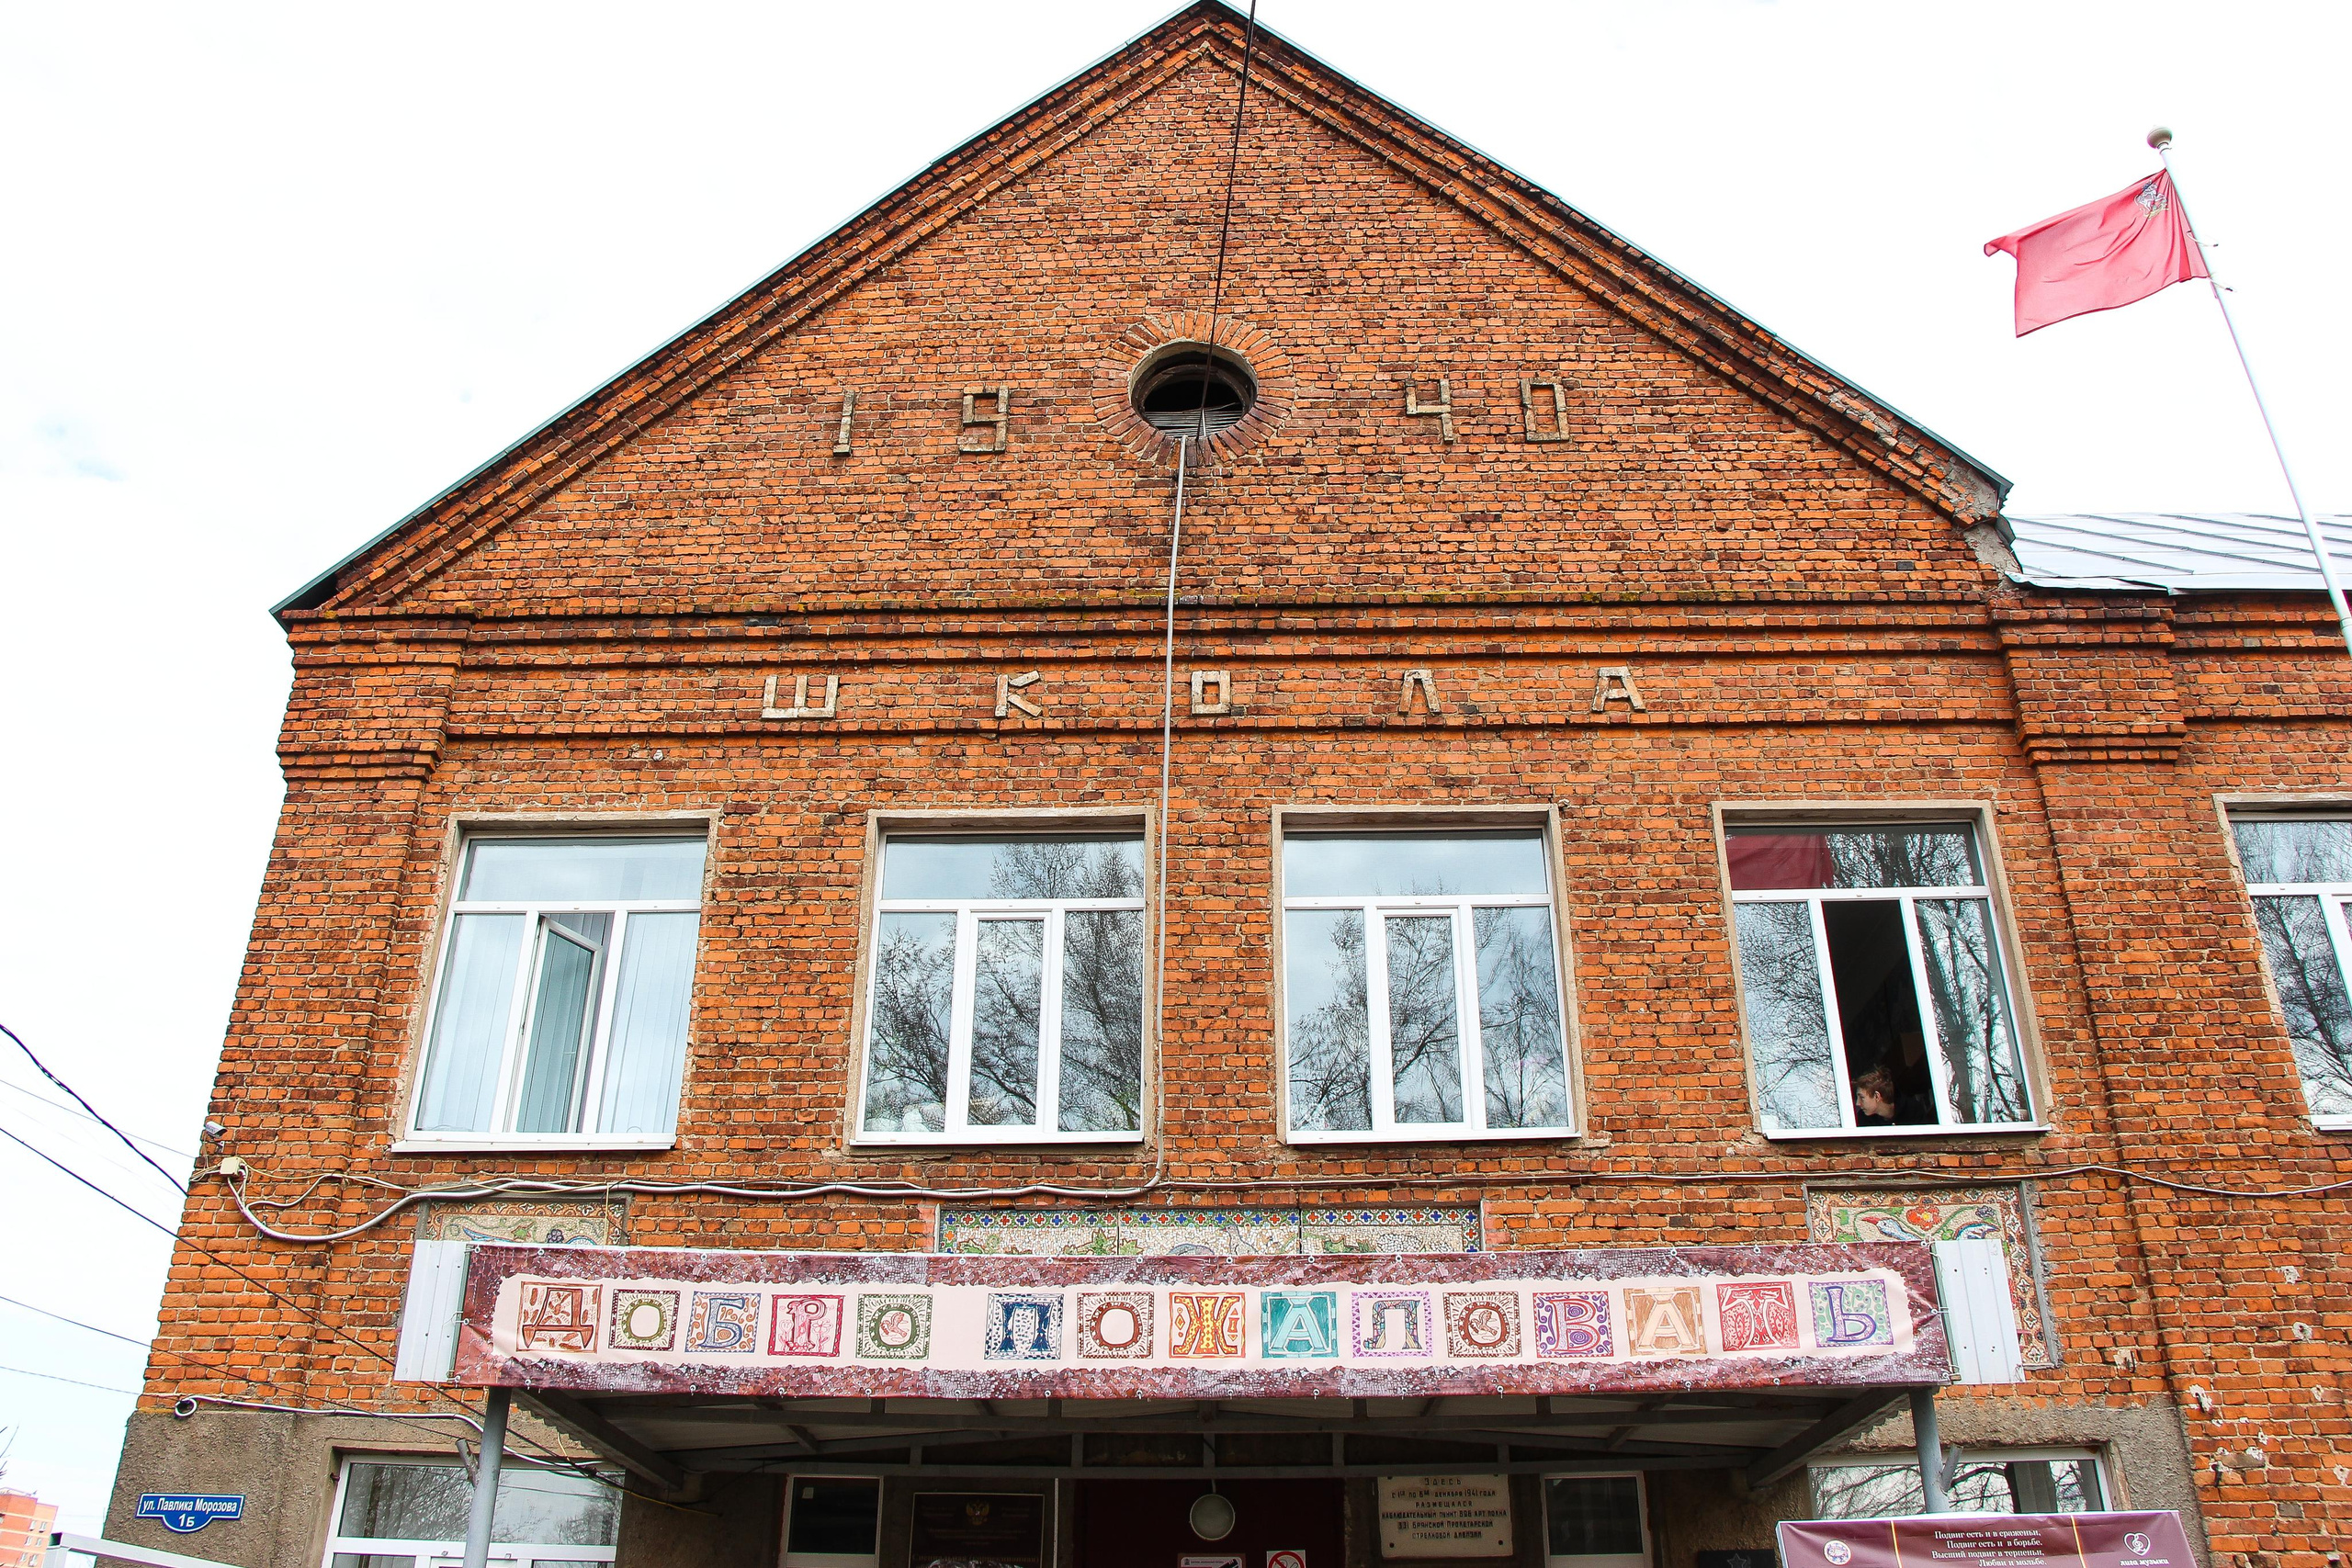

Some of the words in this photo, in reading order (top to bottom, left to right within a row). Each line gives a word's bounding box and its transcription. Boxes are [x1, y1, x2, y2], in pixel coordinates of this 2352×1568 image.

[762, 666, 1646, 719] ШКОЛА
[521, 1286, 922, 1350] ДОБРО
[995, 1286, 1878, 1355] ПОЖАЛОВАТЬ
[1424, 1477, 1462, 1485] ЗДЕСЬ
[1464, 1489, 1478, 1497] 1941
[141, 1500, 155, 1514] ул.
[156, 1497, 194, 1512] Павлика
[194, 1498, 237, 1515] Морозова
[1412, 1520, 1444, 1529] БРЯНСКОЙ
[1934, 1530, 1965, 1540] Подвиг
[1947, 1540, 1977, 1549] Подвиг
[1931, 1550, 1966, 1559] Высший
[1968, 1550, 1997, 1558] подвиг
[1979, 1559, 2007, 1567] Любви
[2139, 1559, 2169, 1567] музыки
